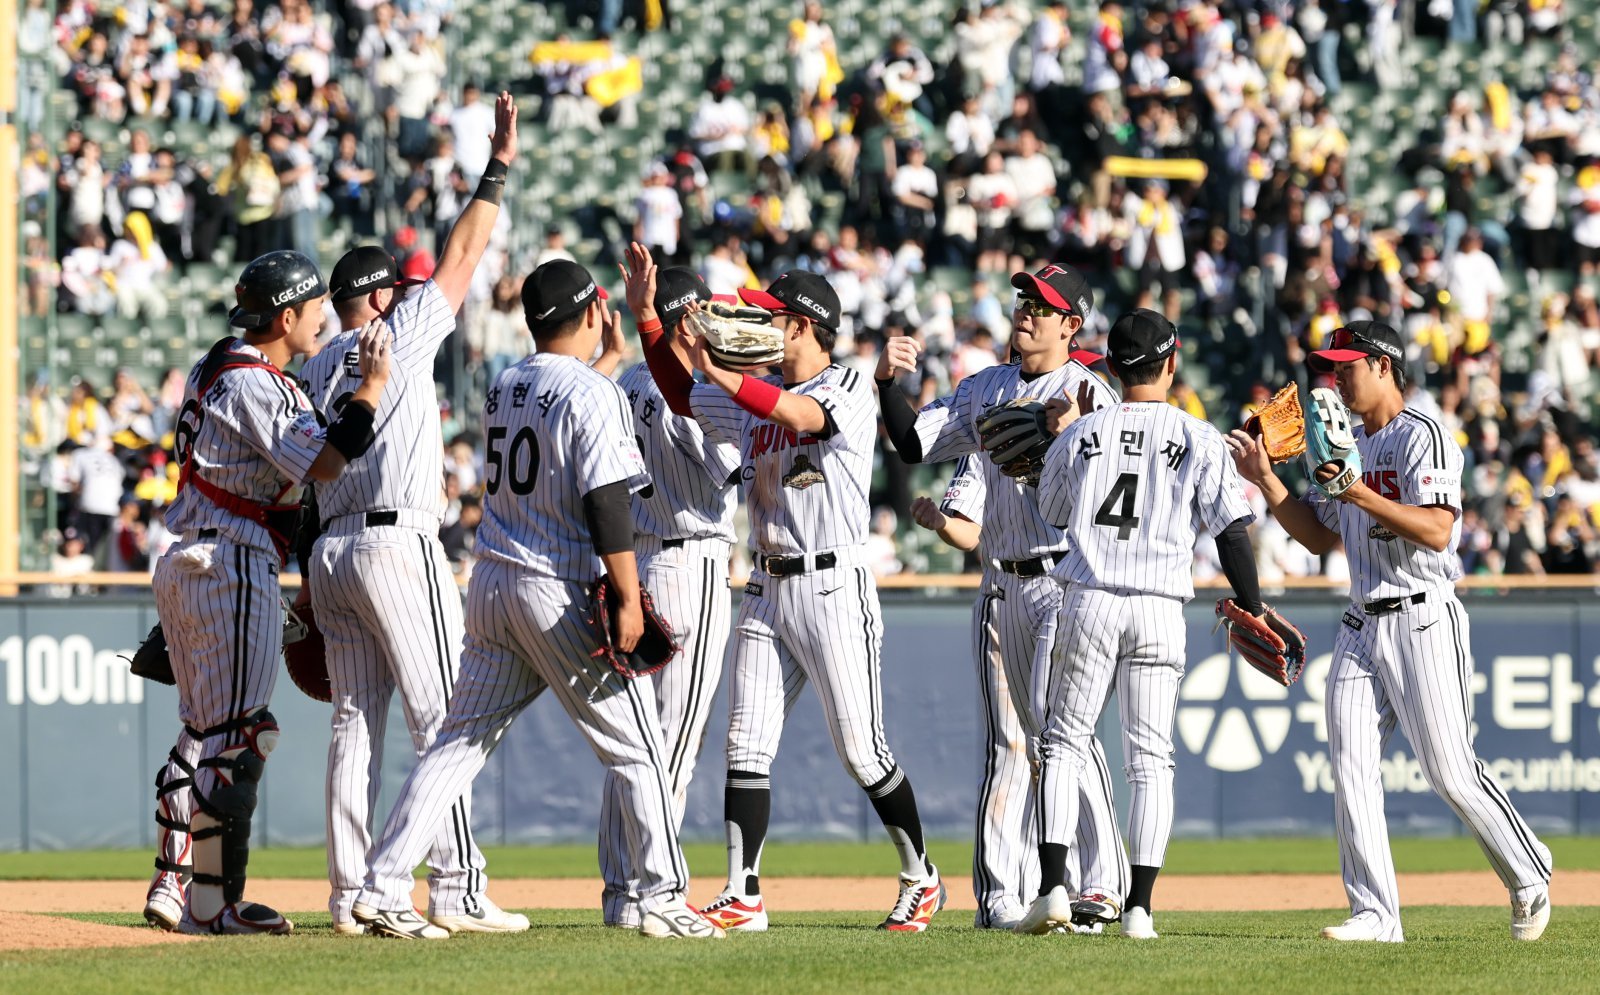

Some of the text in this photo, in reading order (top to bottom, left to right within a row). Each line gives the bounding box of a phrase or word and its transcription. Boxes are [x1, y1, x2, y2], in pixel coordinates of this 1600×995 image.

[272, 274, 319, 306] LGE.COM
[353, 268, 389, 288] LGE.COM
[664, 291, 698, 312] LGE.COM
[797, 293, 830, 319] LGE.COM
[486, 426, 540, 496] 50
[1078, 430, 1190, 471] 신민재
[1376, 450, 1394, 467] LG
[742, 465, 756, 481] C
[1094, 471, 1141, 542] 4
[0, 633, 145, 705] 100m
